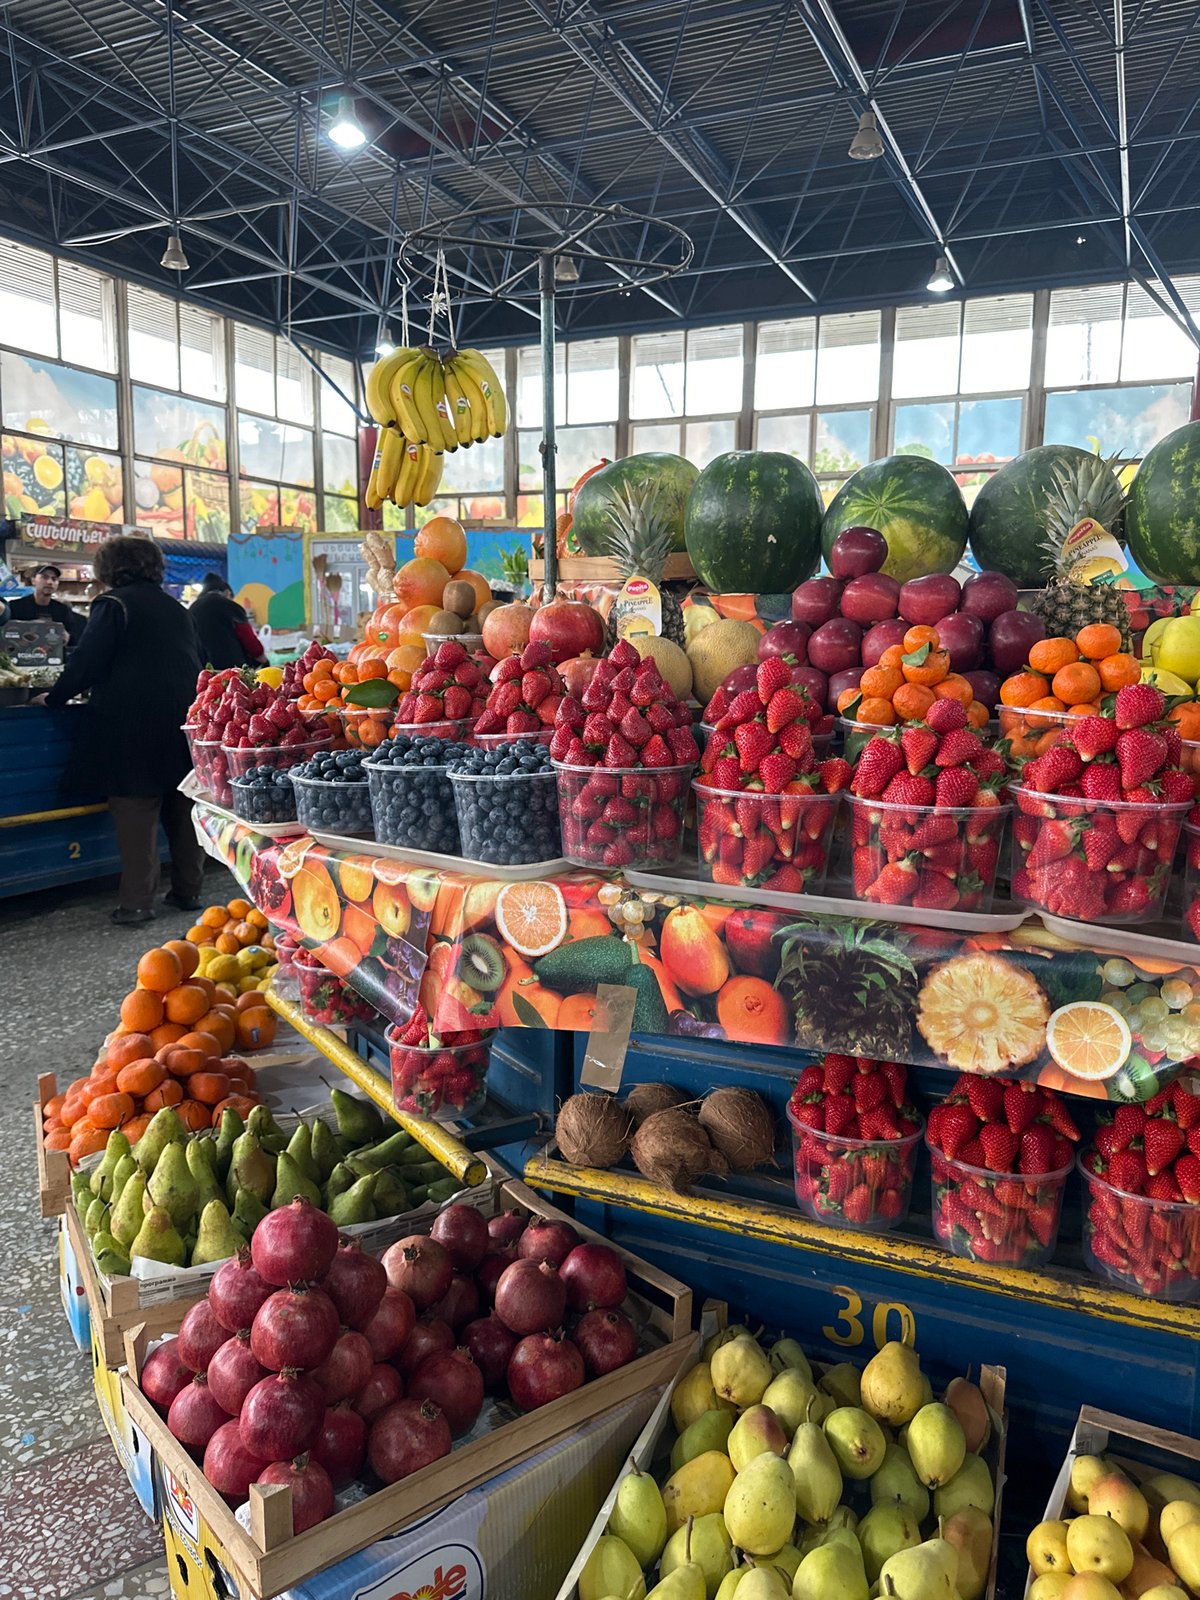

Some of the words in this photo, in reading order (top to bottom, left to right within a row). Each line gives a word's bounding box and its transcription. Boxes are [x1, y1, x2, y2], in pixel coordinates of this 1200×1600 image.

[1068, 534, 1103, 556] PINEAPPLE
[68, 842, 81, 859] 2
[822, 1285, 916, 1350] 30
